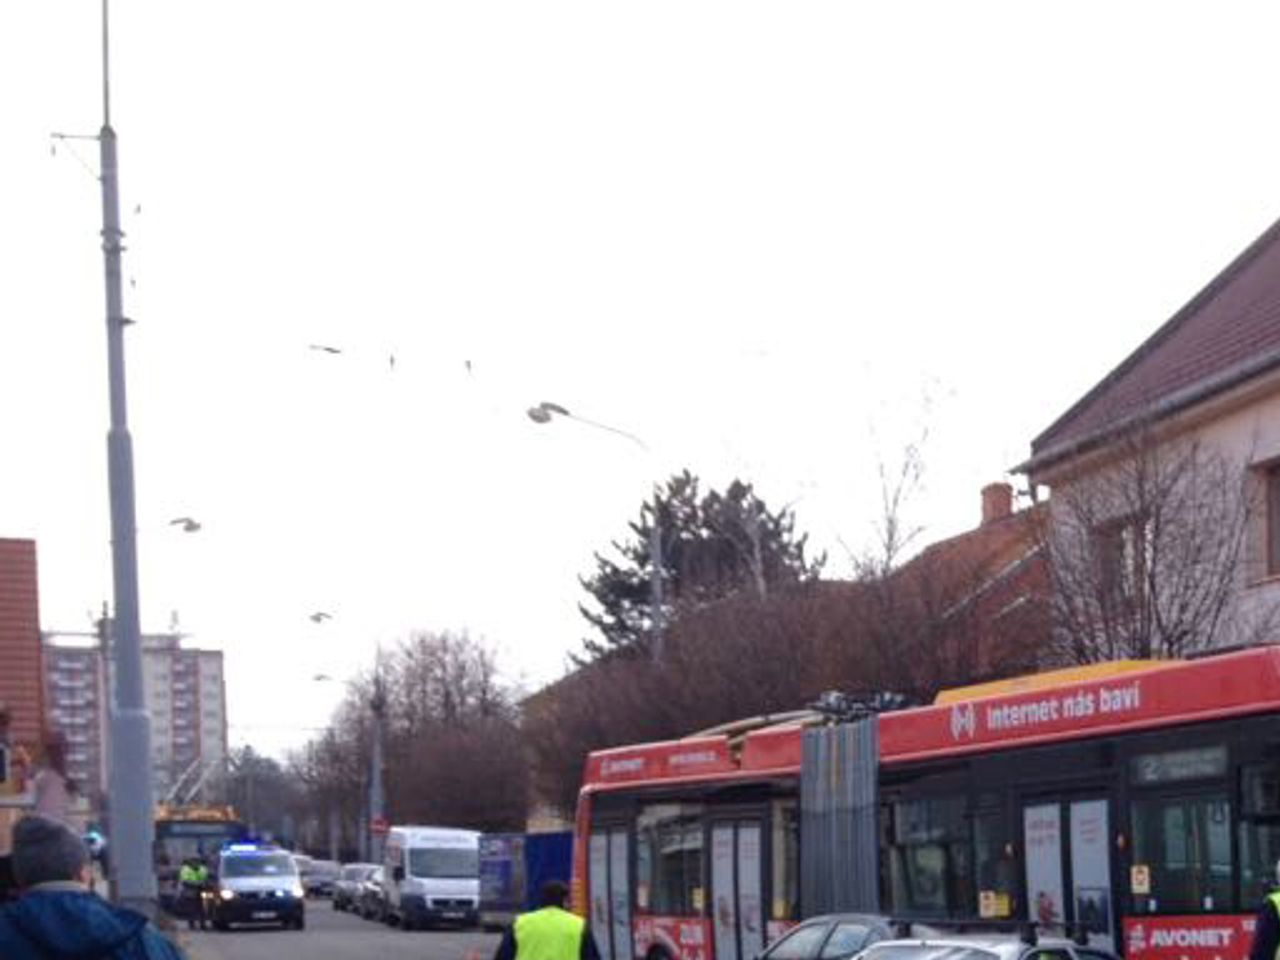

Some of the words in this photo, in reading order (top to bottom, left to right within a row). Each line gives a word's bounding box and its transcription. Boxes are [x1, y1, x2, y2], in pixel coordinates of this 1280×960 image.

[987, 700, 1059, 731] Internet
[1063, 690, 1094, 718] nás
[1099, 680, 1140, 713] baví
[1150, 928, 1233, 948] AVONET
